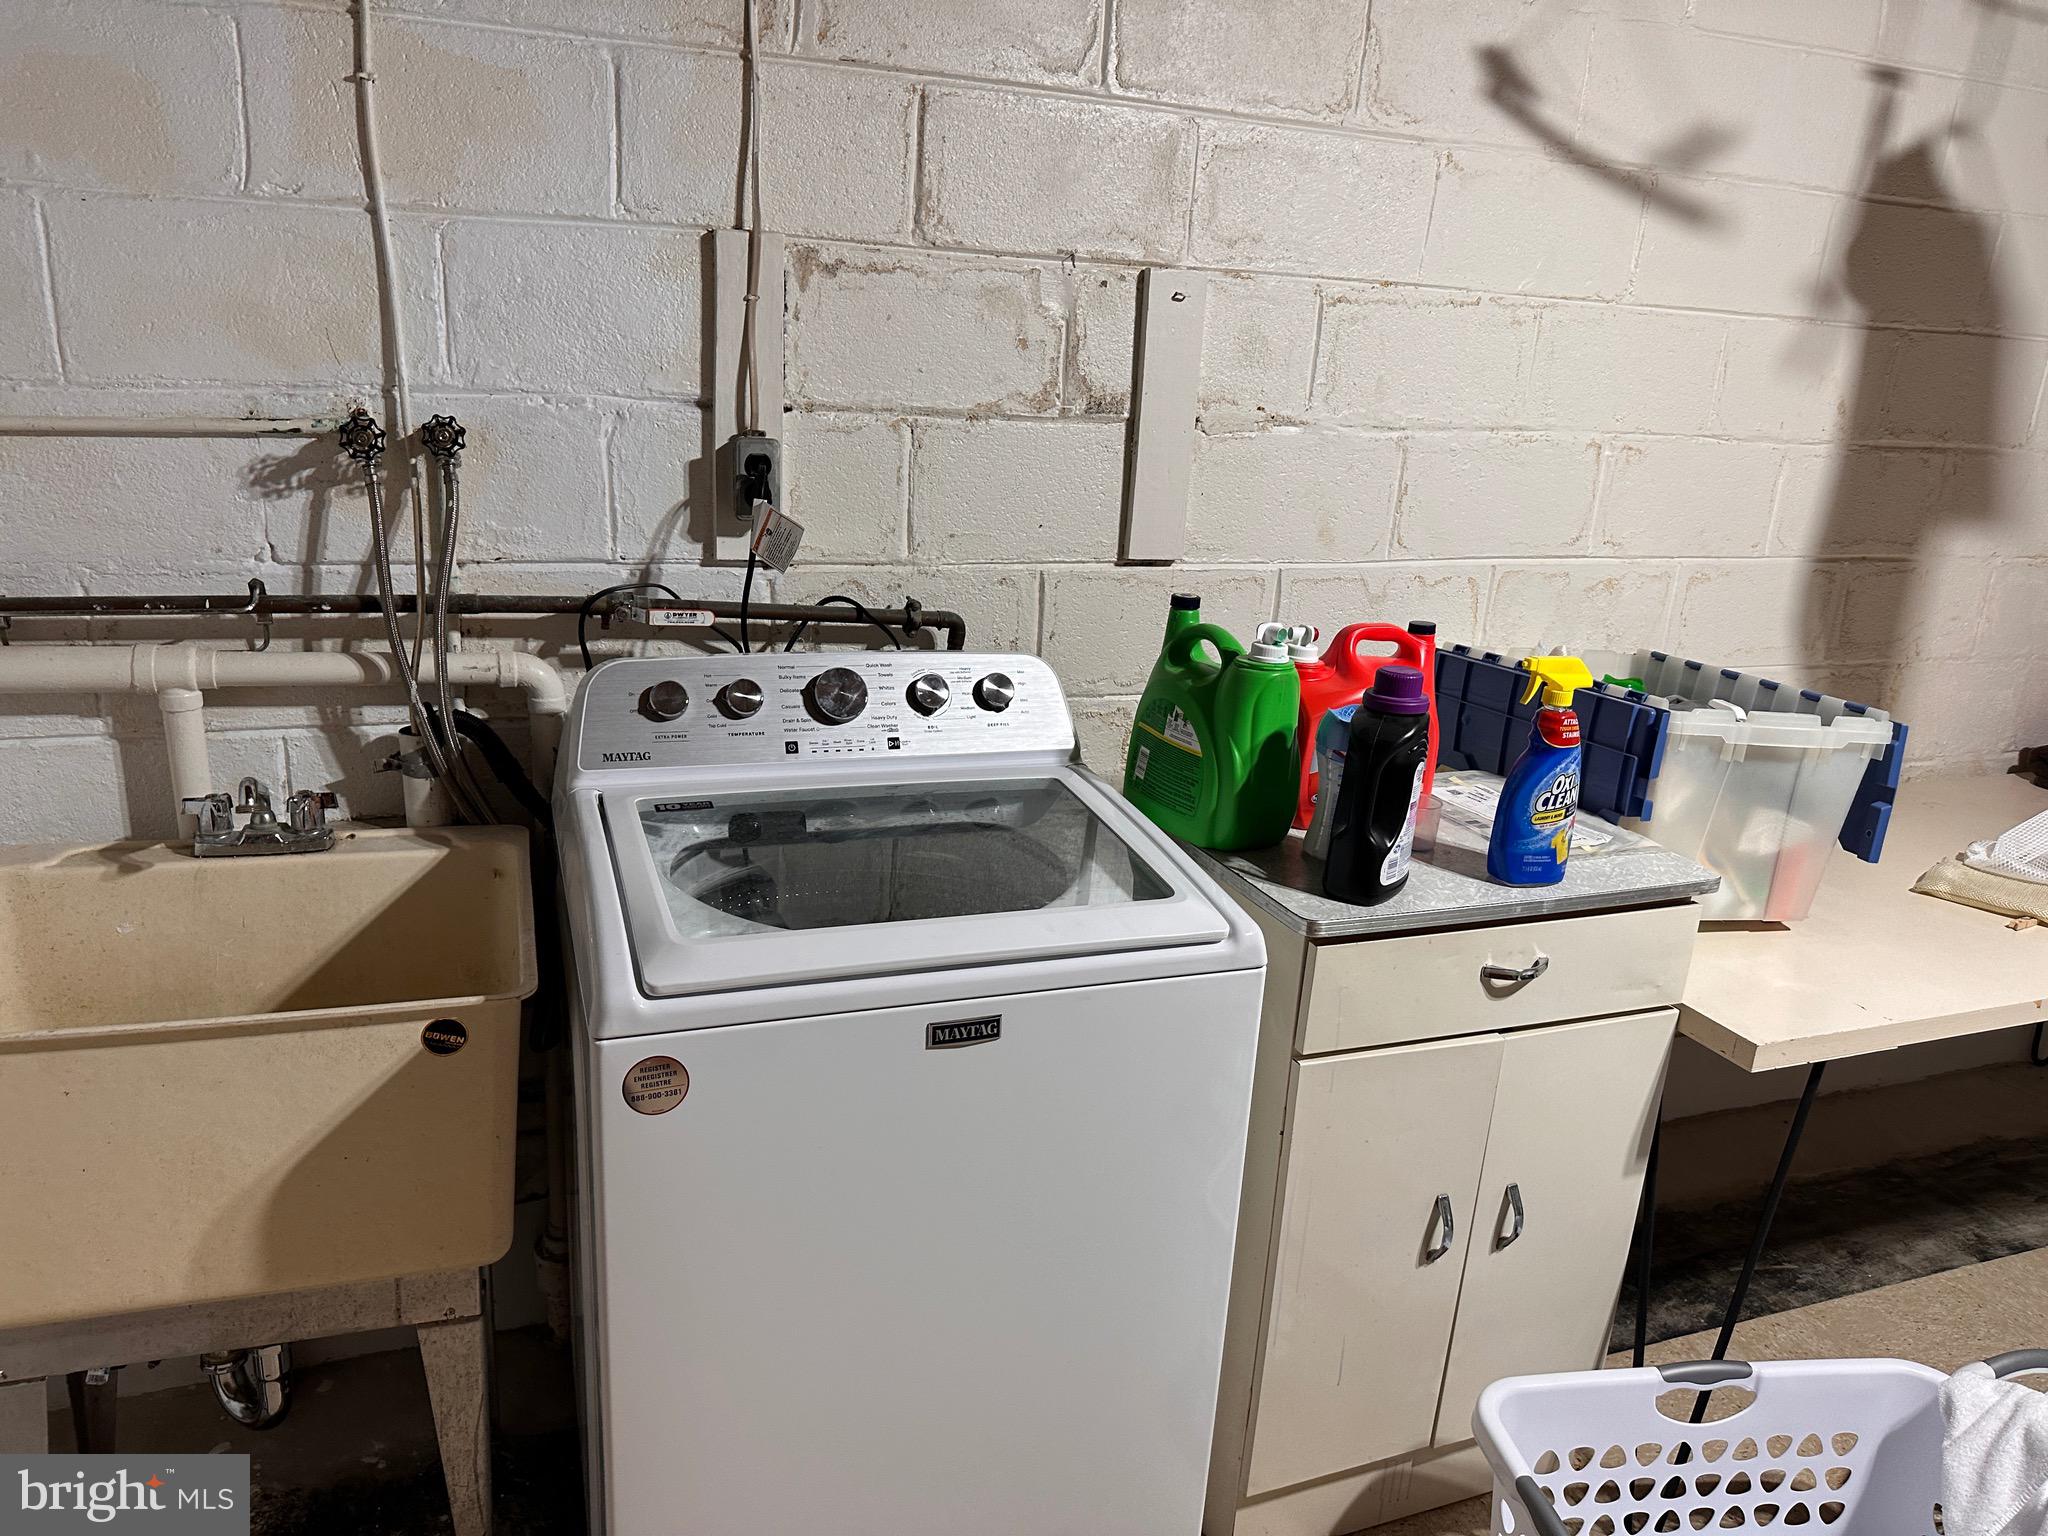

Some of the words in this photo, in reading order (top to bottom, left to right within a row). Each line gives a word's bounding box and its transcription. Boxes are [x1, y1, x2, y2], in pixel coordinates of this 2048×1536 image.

[602, 751, 651, 763] MAYTAG
[1551, 774, 1576, 796] OXI
[1535, 786, 1577, 812] CLEAN
[656, 803, 681, 811] 10
[424, 1030, 465, 1044] BOWEN
[934, 1021, 998, 1042] MAYTAG
[639, 1063, 672, 1074] REGISTER
[633, 1070, 678, 1083] ENREGISTRER
[640, 1078, 672, 1089] REGISTRE
